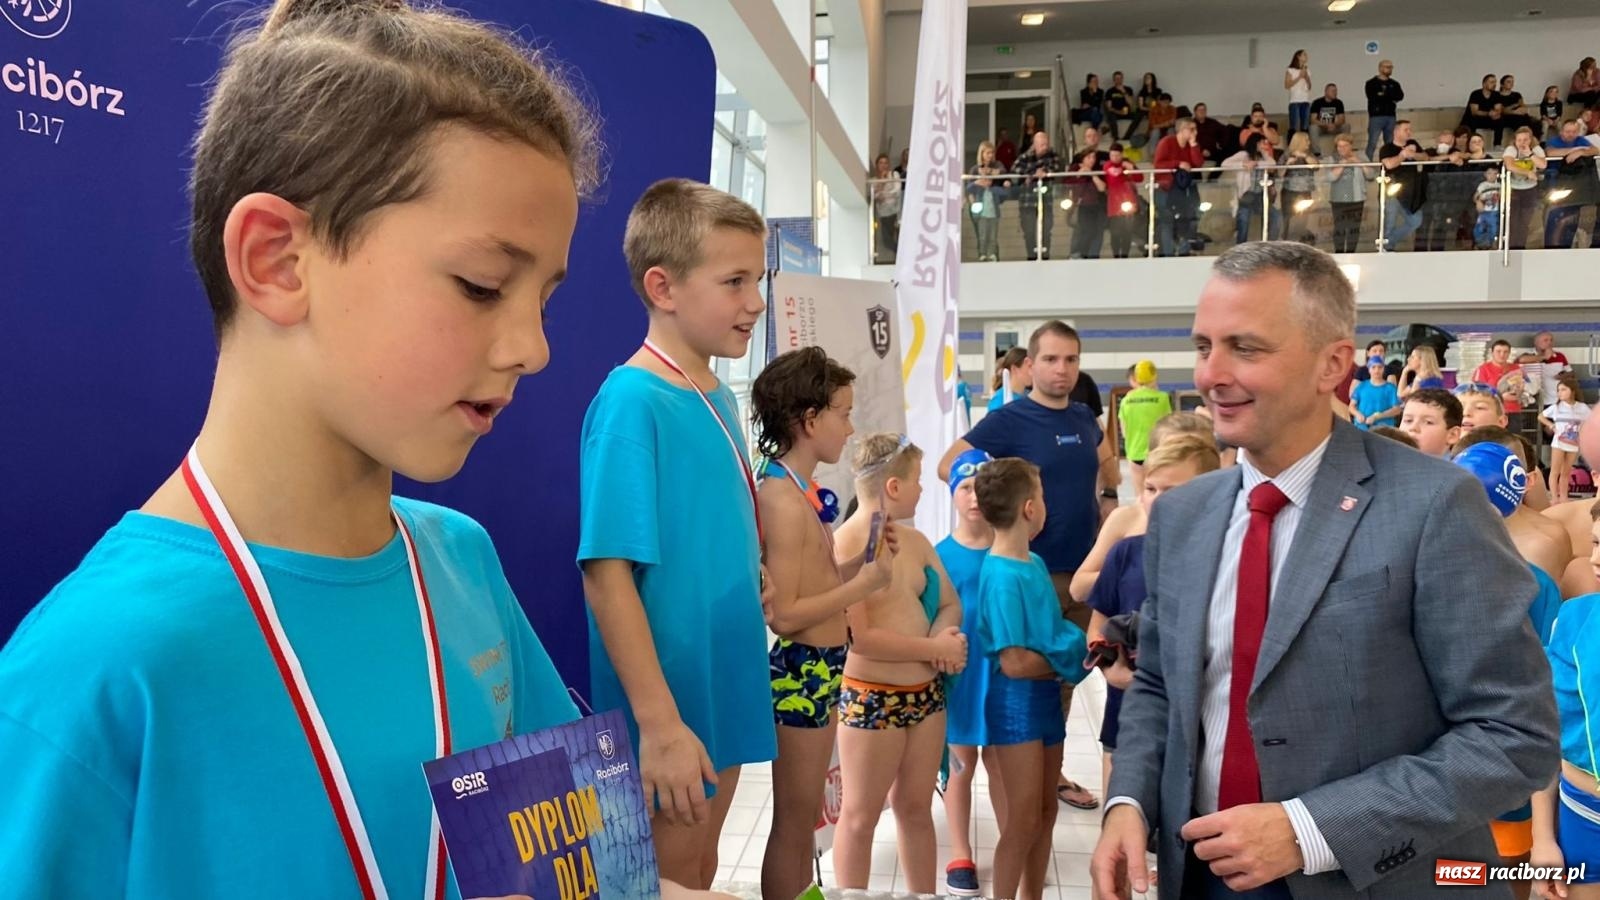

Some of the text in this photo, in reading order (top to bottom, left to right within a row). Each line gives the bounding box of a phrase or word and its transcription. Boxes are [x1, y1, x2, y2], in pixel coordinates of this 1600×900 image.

[17, 110, 64, 144] 1217
[785, 296, 796, 318] 15
[872, 321, 888, 345] 15
[596, 762, 629, 780] Racibórz
[508, 784, 604, 864] DYPLOM
[553, 846, 598, 900] DLA
